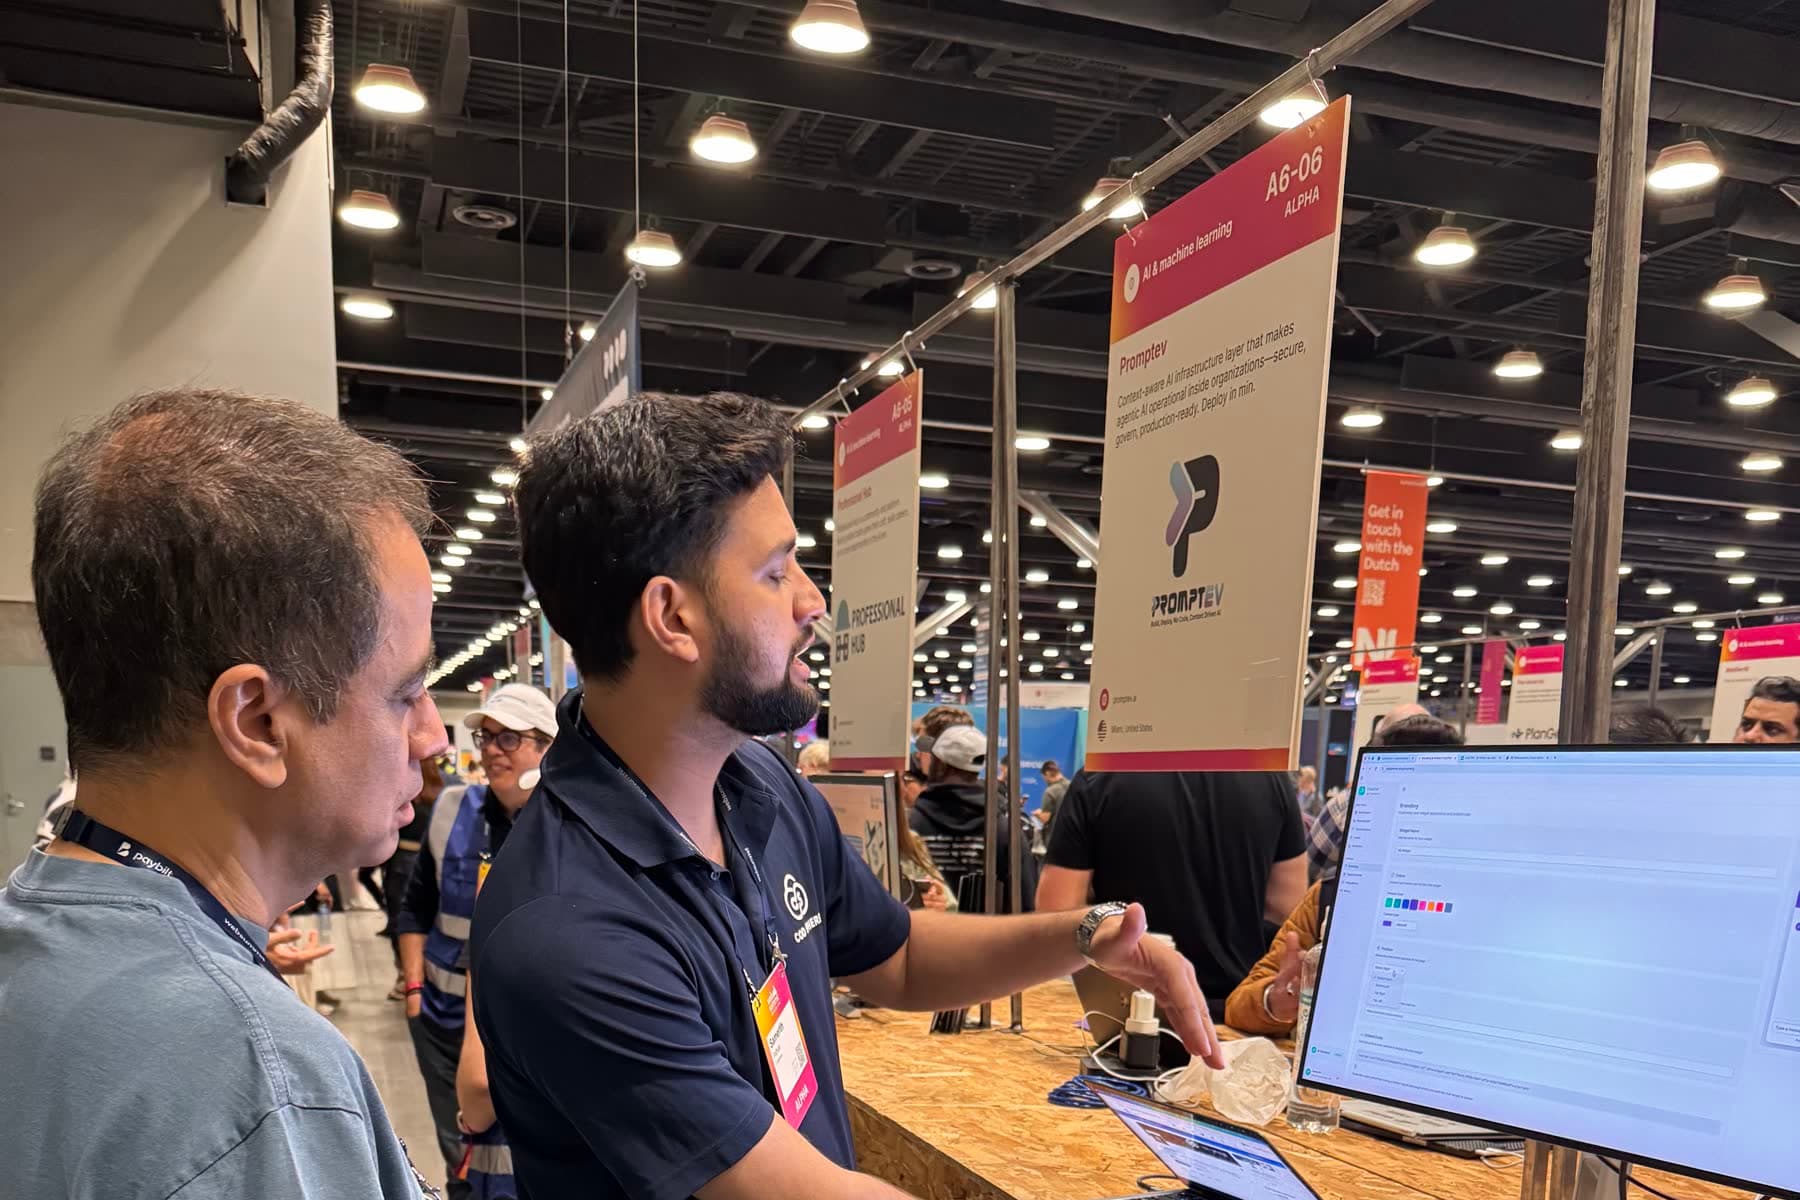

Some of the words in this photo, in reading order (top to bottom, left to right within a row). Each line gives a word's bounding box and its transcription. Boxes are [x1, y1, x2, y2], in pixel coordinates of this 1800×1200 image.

[1265, 145, 1323, 202] A6-06
[1284, 185, 1320, 218] ALPHA
[1142, 264, 1152, 282] AI
[1152, 260, 1158, 277] &
[1159, 242, 1195, 273] machine
[1195, 220, 1233, 252] learning
[1118, 378, 1165, 408] Context-aware
[1175, 351, 1224, 384] infrastructure
[1225, 342, 1245, 362] layer
[1246, 333, 1264, 352] that
[1265, 322, 1295, 344] makes
[1120, 340, 1168, 376] Promptev
[1117, 408, 1140, 429] agentic
[1149, 386, 1187, 414] operational
[1188, 376, 1210, 398] inside
[1201, 391, 1229, 412] Deploy
[1238, 379, 1256, 398] min.
[1368, 504, 1391, 519] Get
[1392, 504, 1404, 520] in
[1367, 522, 1402, 538] touch
[1365, 539, 1392, 554] with
[1393, 541, 1414, 556] the
[1363, 556, 1400, 573] Dutch
[852, 596, 905, 628] PROFESSIONAL
[1151, 583, 1224, 617] PROMPTEV
[851, 634, 865, 654] HUB
[133, 852, 173, 878] paybilt
